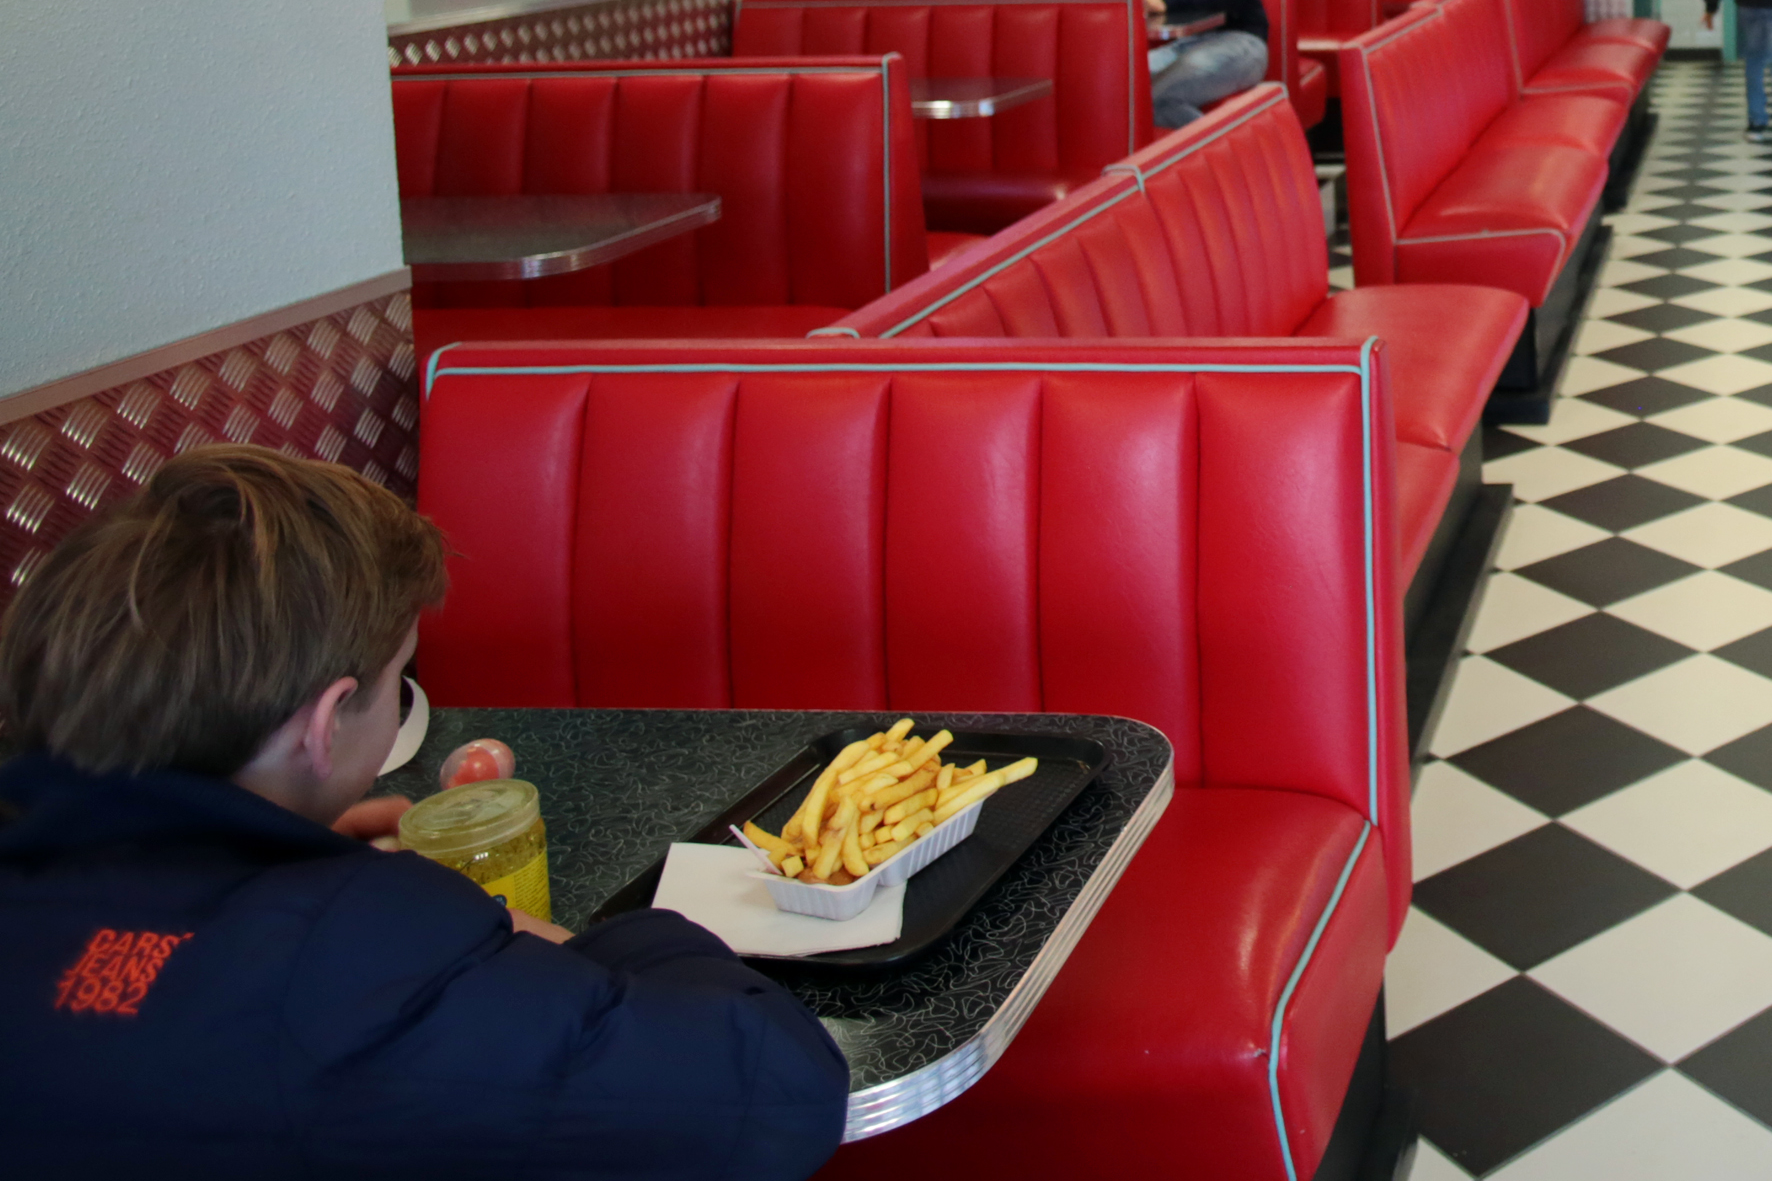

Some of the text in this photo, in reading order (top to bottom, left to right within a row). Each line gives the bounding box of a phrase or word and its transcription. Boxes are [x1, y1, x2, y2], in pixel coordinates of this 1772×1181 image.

[88, 928, 183, 960] CARS
[64, 953, 165, 984] JEANS
[54, 977, 149, 1016] 1982
